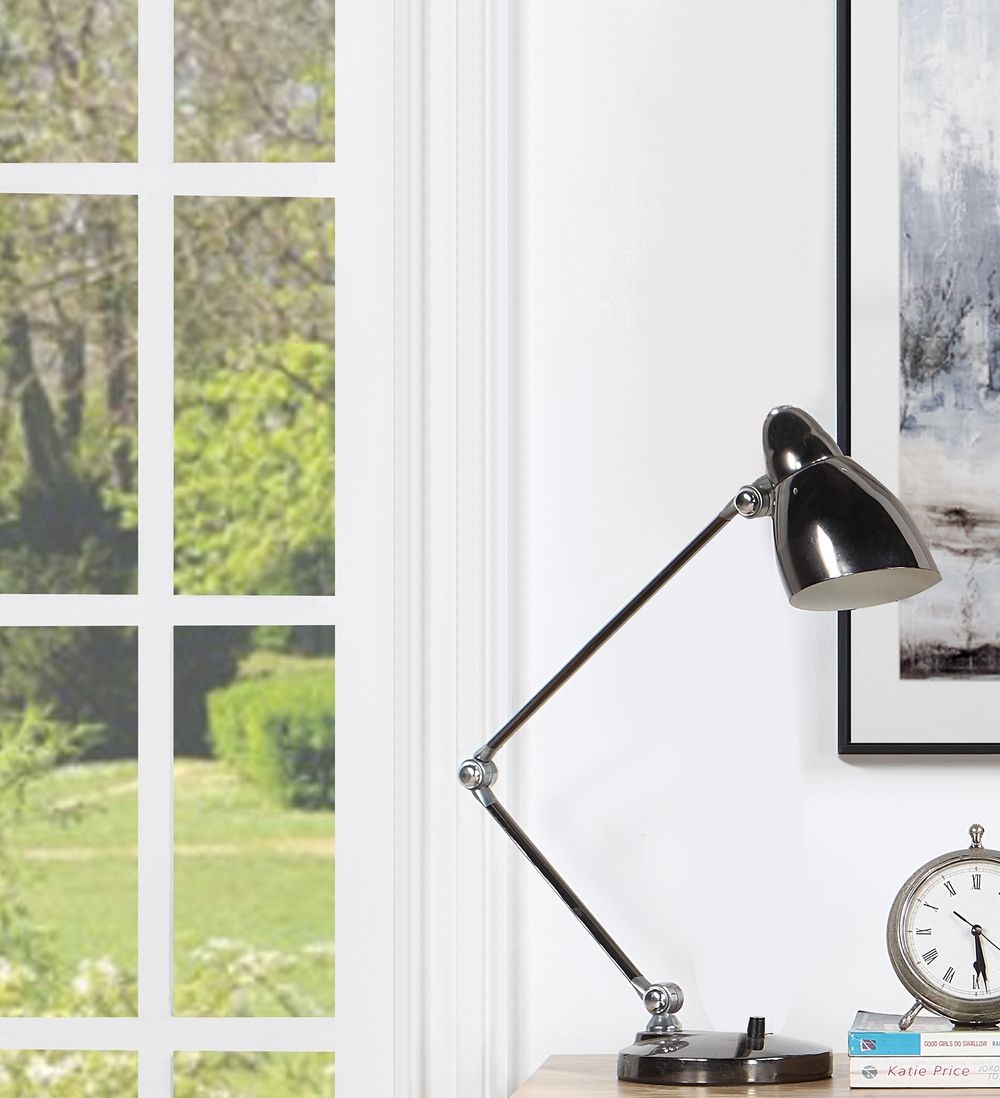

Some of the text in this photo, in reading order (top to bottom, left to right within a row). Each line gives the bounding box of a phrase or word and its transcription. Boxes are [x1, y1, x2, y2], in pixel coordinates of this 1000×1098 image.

[943, 881, 957, 897] XI
[971, 874, 981, 890] XII
[921, 948, 939, 966] VIII
[887, 1065, 970, 1077] Katie Price
[987, 1072, 999, 1080] TO
